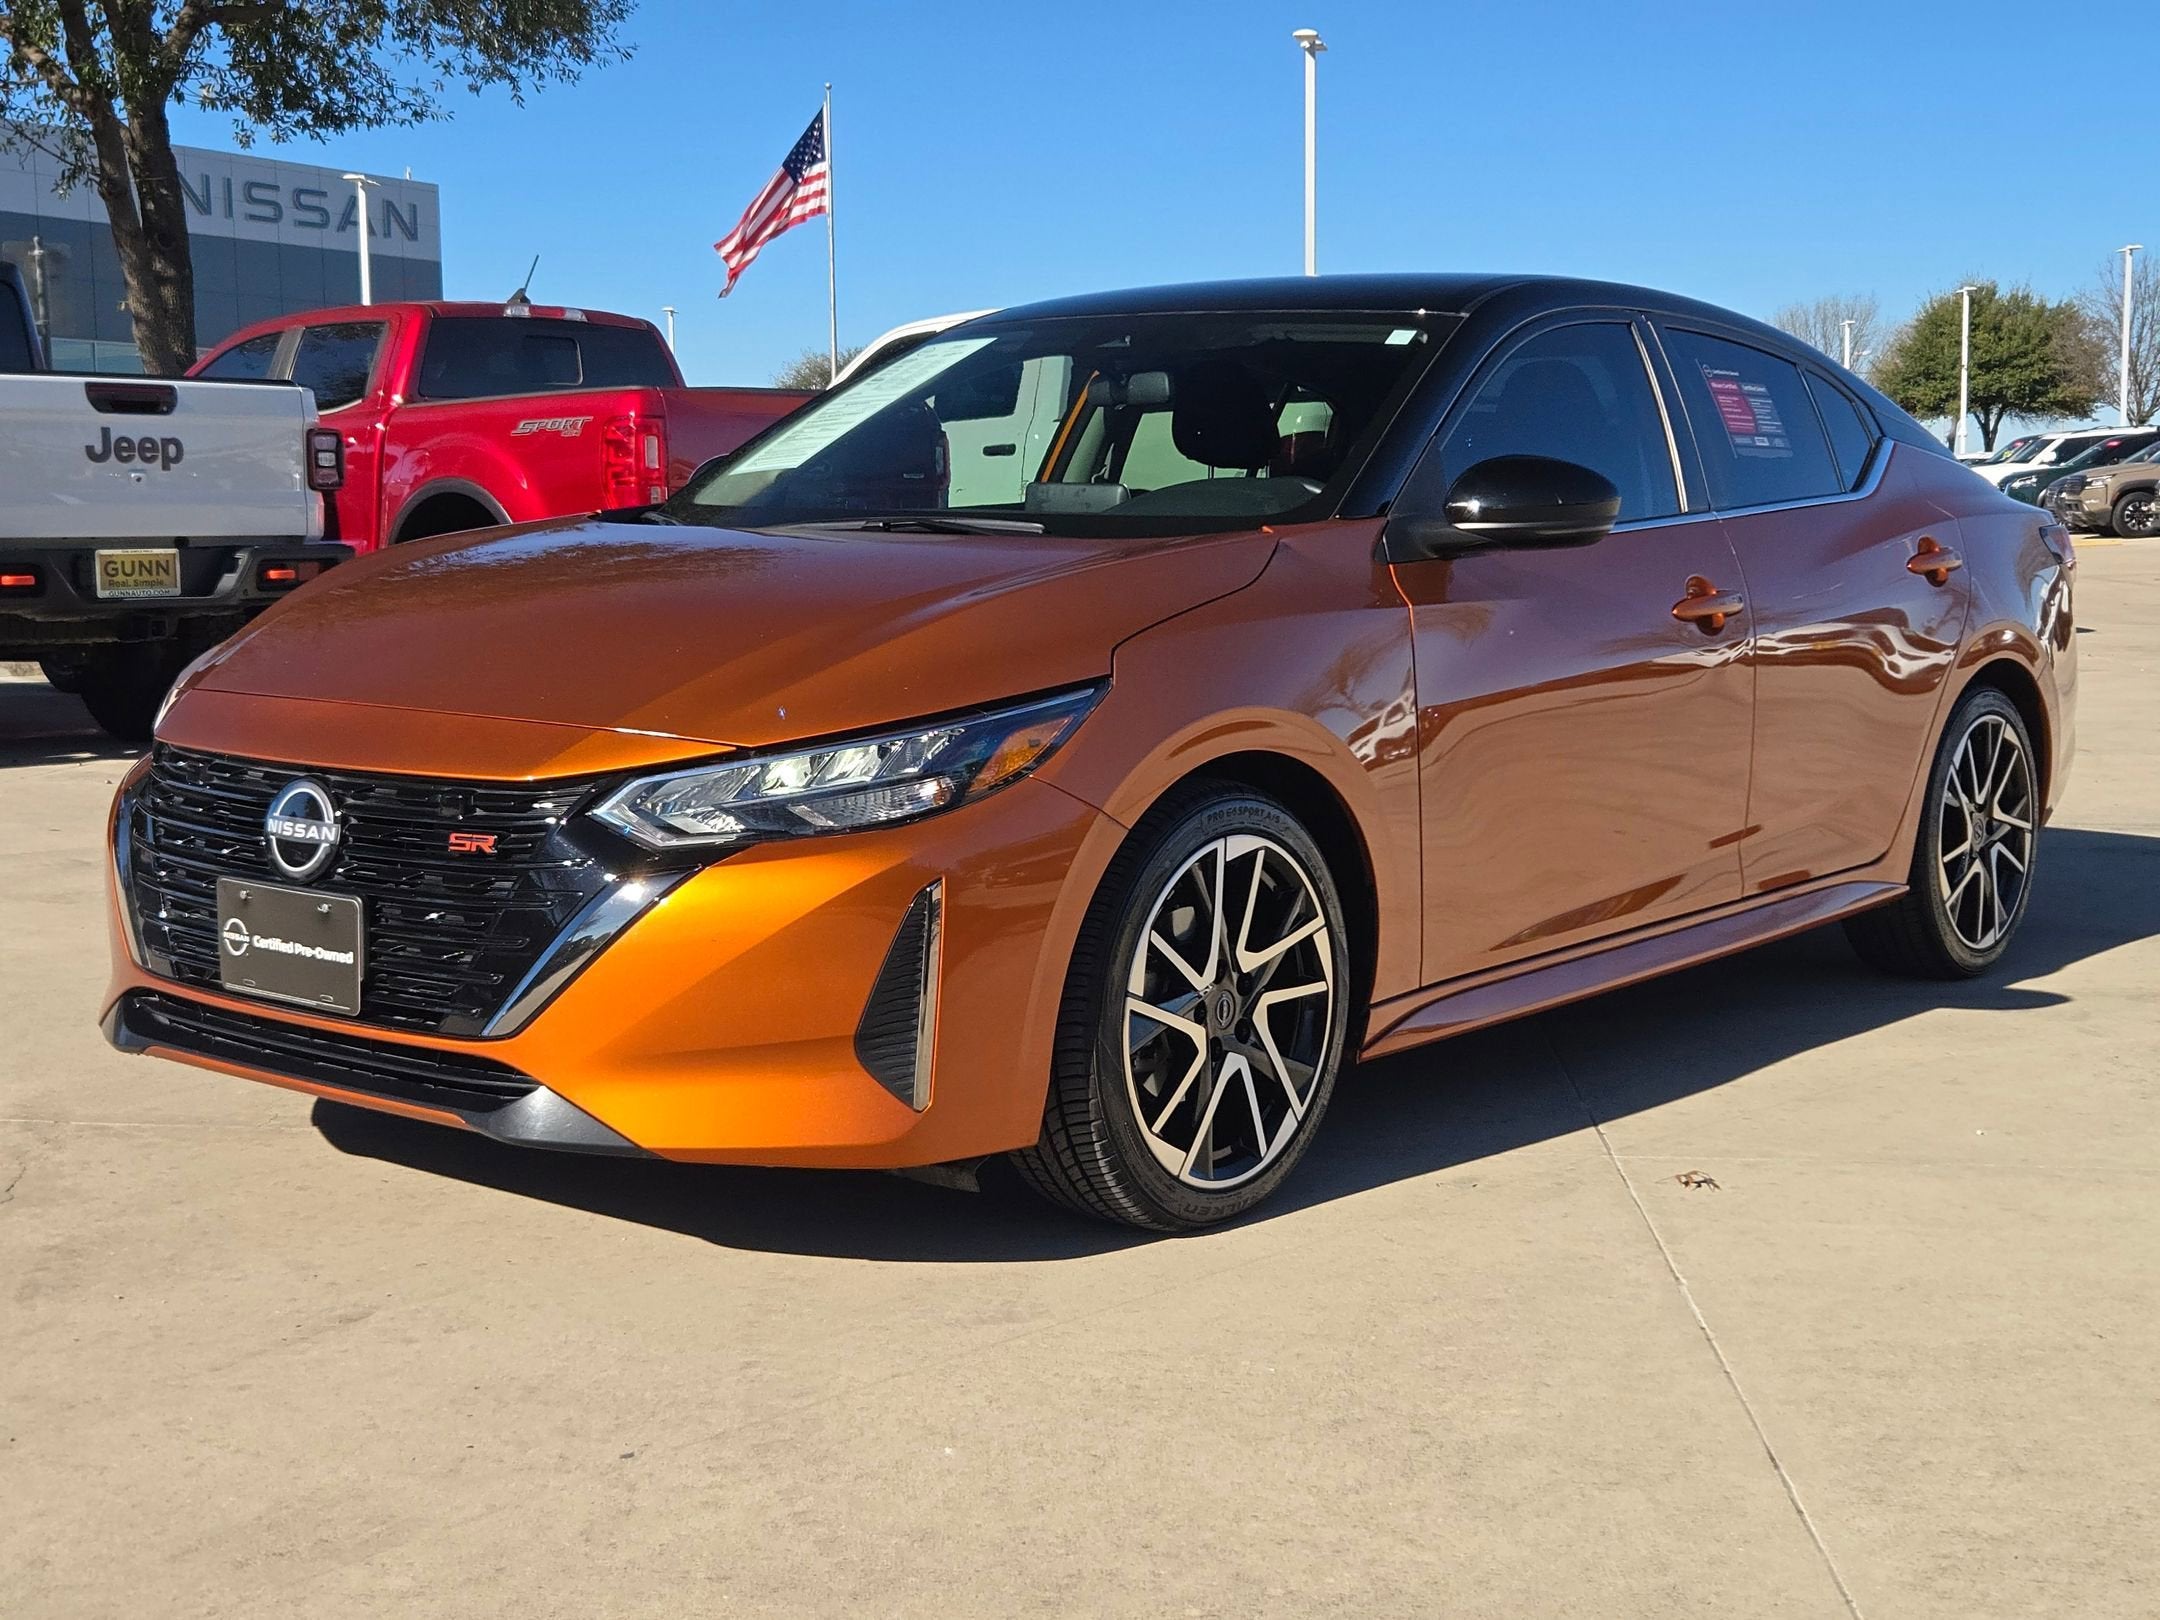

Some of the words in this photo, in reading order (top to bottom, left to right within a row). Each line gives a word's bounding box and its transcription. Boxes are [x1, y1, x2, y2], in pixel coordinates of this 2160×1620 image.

[177, 171, 418, 242] NISSAN
[510, 416, 594, 436] SPORT
[85, 426, 184, 471] Jeep
[104, 560, 170, 578] GUNN
[108, 589, 170, 597] GUNNAUTO.COM
[267, 818, 336, 842] NISSAN
[448, 833, 497, 853] SR
[252, 935, 294, 954] Certified
[294, 943, 354, 964] Pre-Owned
